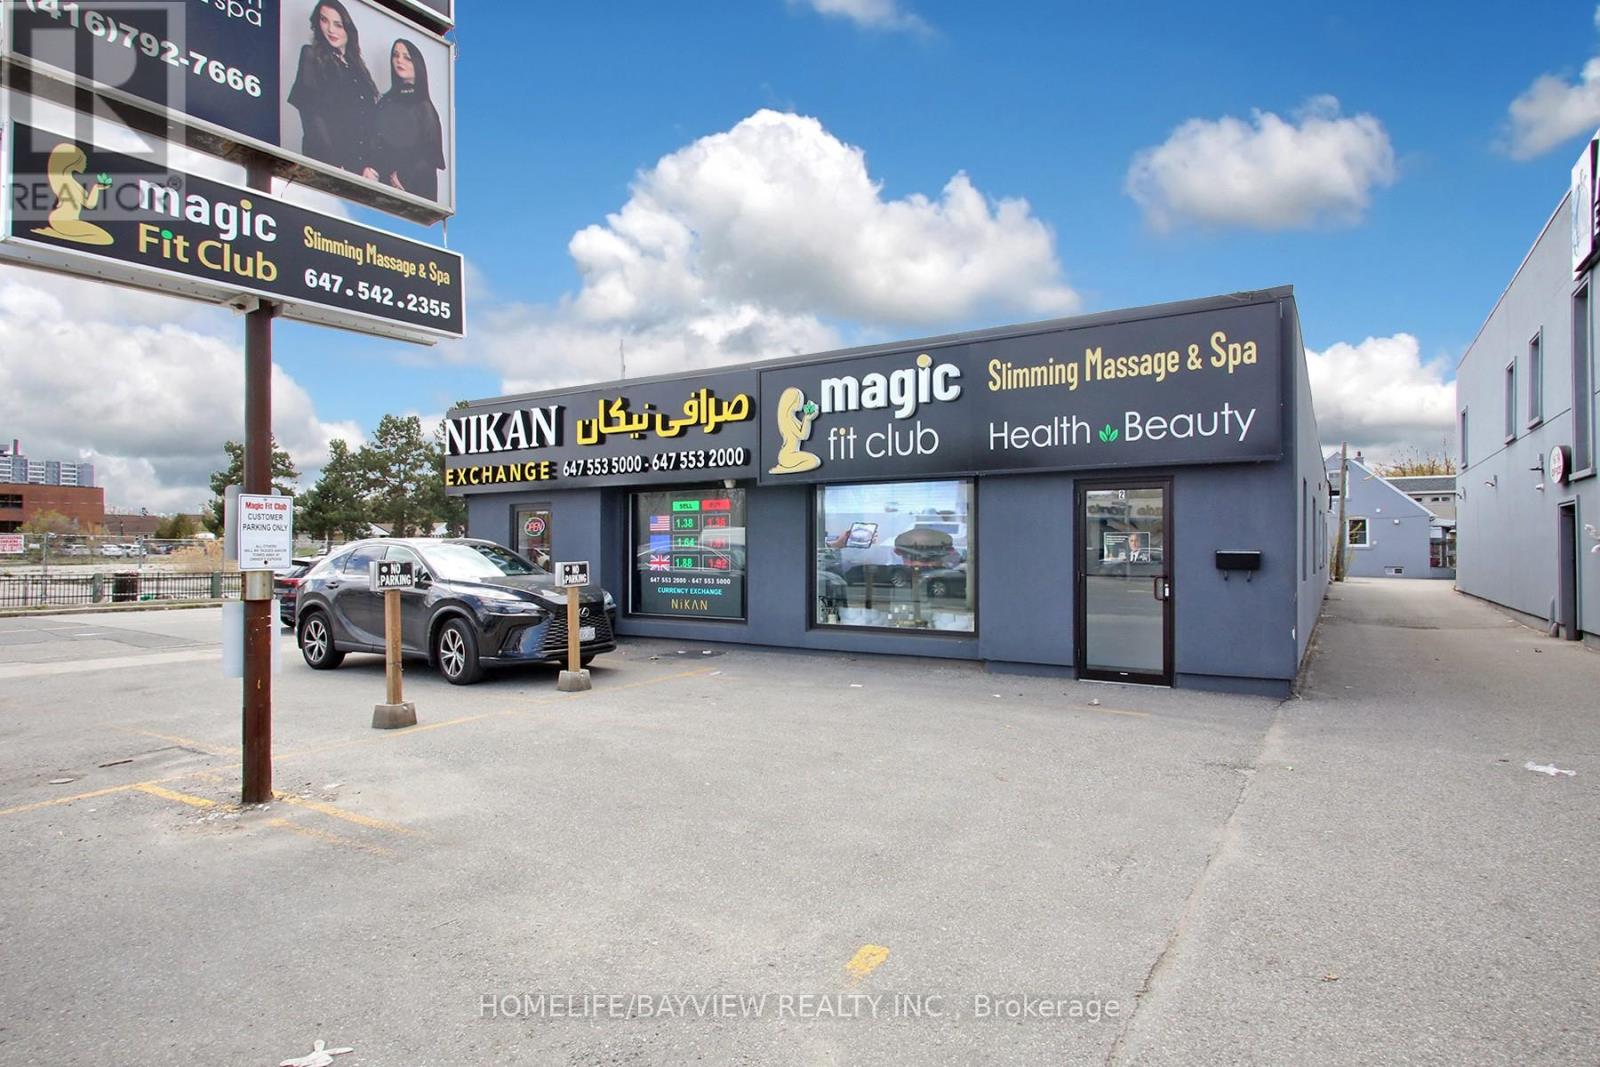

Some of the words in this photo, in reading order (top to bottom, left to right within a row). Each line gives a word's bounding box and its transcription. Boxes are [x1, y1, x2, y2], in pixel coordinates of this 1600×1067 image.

[138, 179, 277, 243] magic
[138, 223, 190, 264] Fit
[197, 239, 278, 282] Club
[303, 225, 364, 267] Slimming
[366, 243, 417, 278] Massage
[418, 265, 426, 278] &
[428, 261, 451, 286] Spa
[987, 357, 1078, 392] Slimming
[1085, 347, 1180, 387] Massage
[1187, 342, 1203, 370] &
[1210, 331, 1258, 374] Spa
[820, 353, 962, 420] magic
[443, 405, 561, 456] NIKAN
[827, 427, 858, 461] fit
[865, 420, 940, 459] club
[988, 415, 1091, 451] Health
[1123, 402, 1256, 443] Beauty
[446, 461, 550, 486] EXCHANGE
[562, 459, 585, 478] 647
[586, 457, 610, 476] 553
[611, 454, 642, 474] 5000
[651, 451, 677, 472] 647
[679, 450, 706, 469] 553
[708, 446, 745, 468] 2000
[245, 502, 263, 511] Magic
[265, 502, 273, 510] Fit
[274, 503, 288, 511] Club
[380, 574, 412, 587] PARKING
[390, 563, 401, 575] NO
[657, 587, 688, 595] CURRENCY
[689, 588, 723, 596] EXCHANGE
